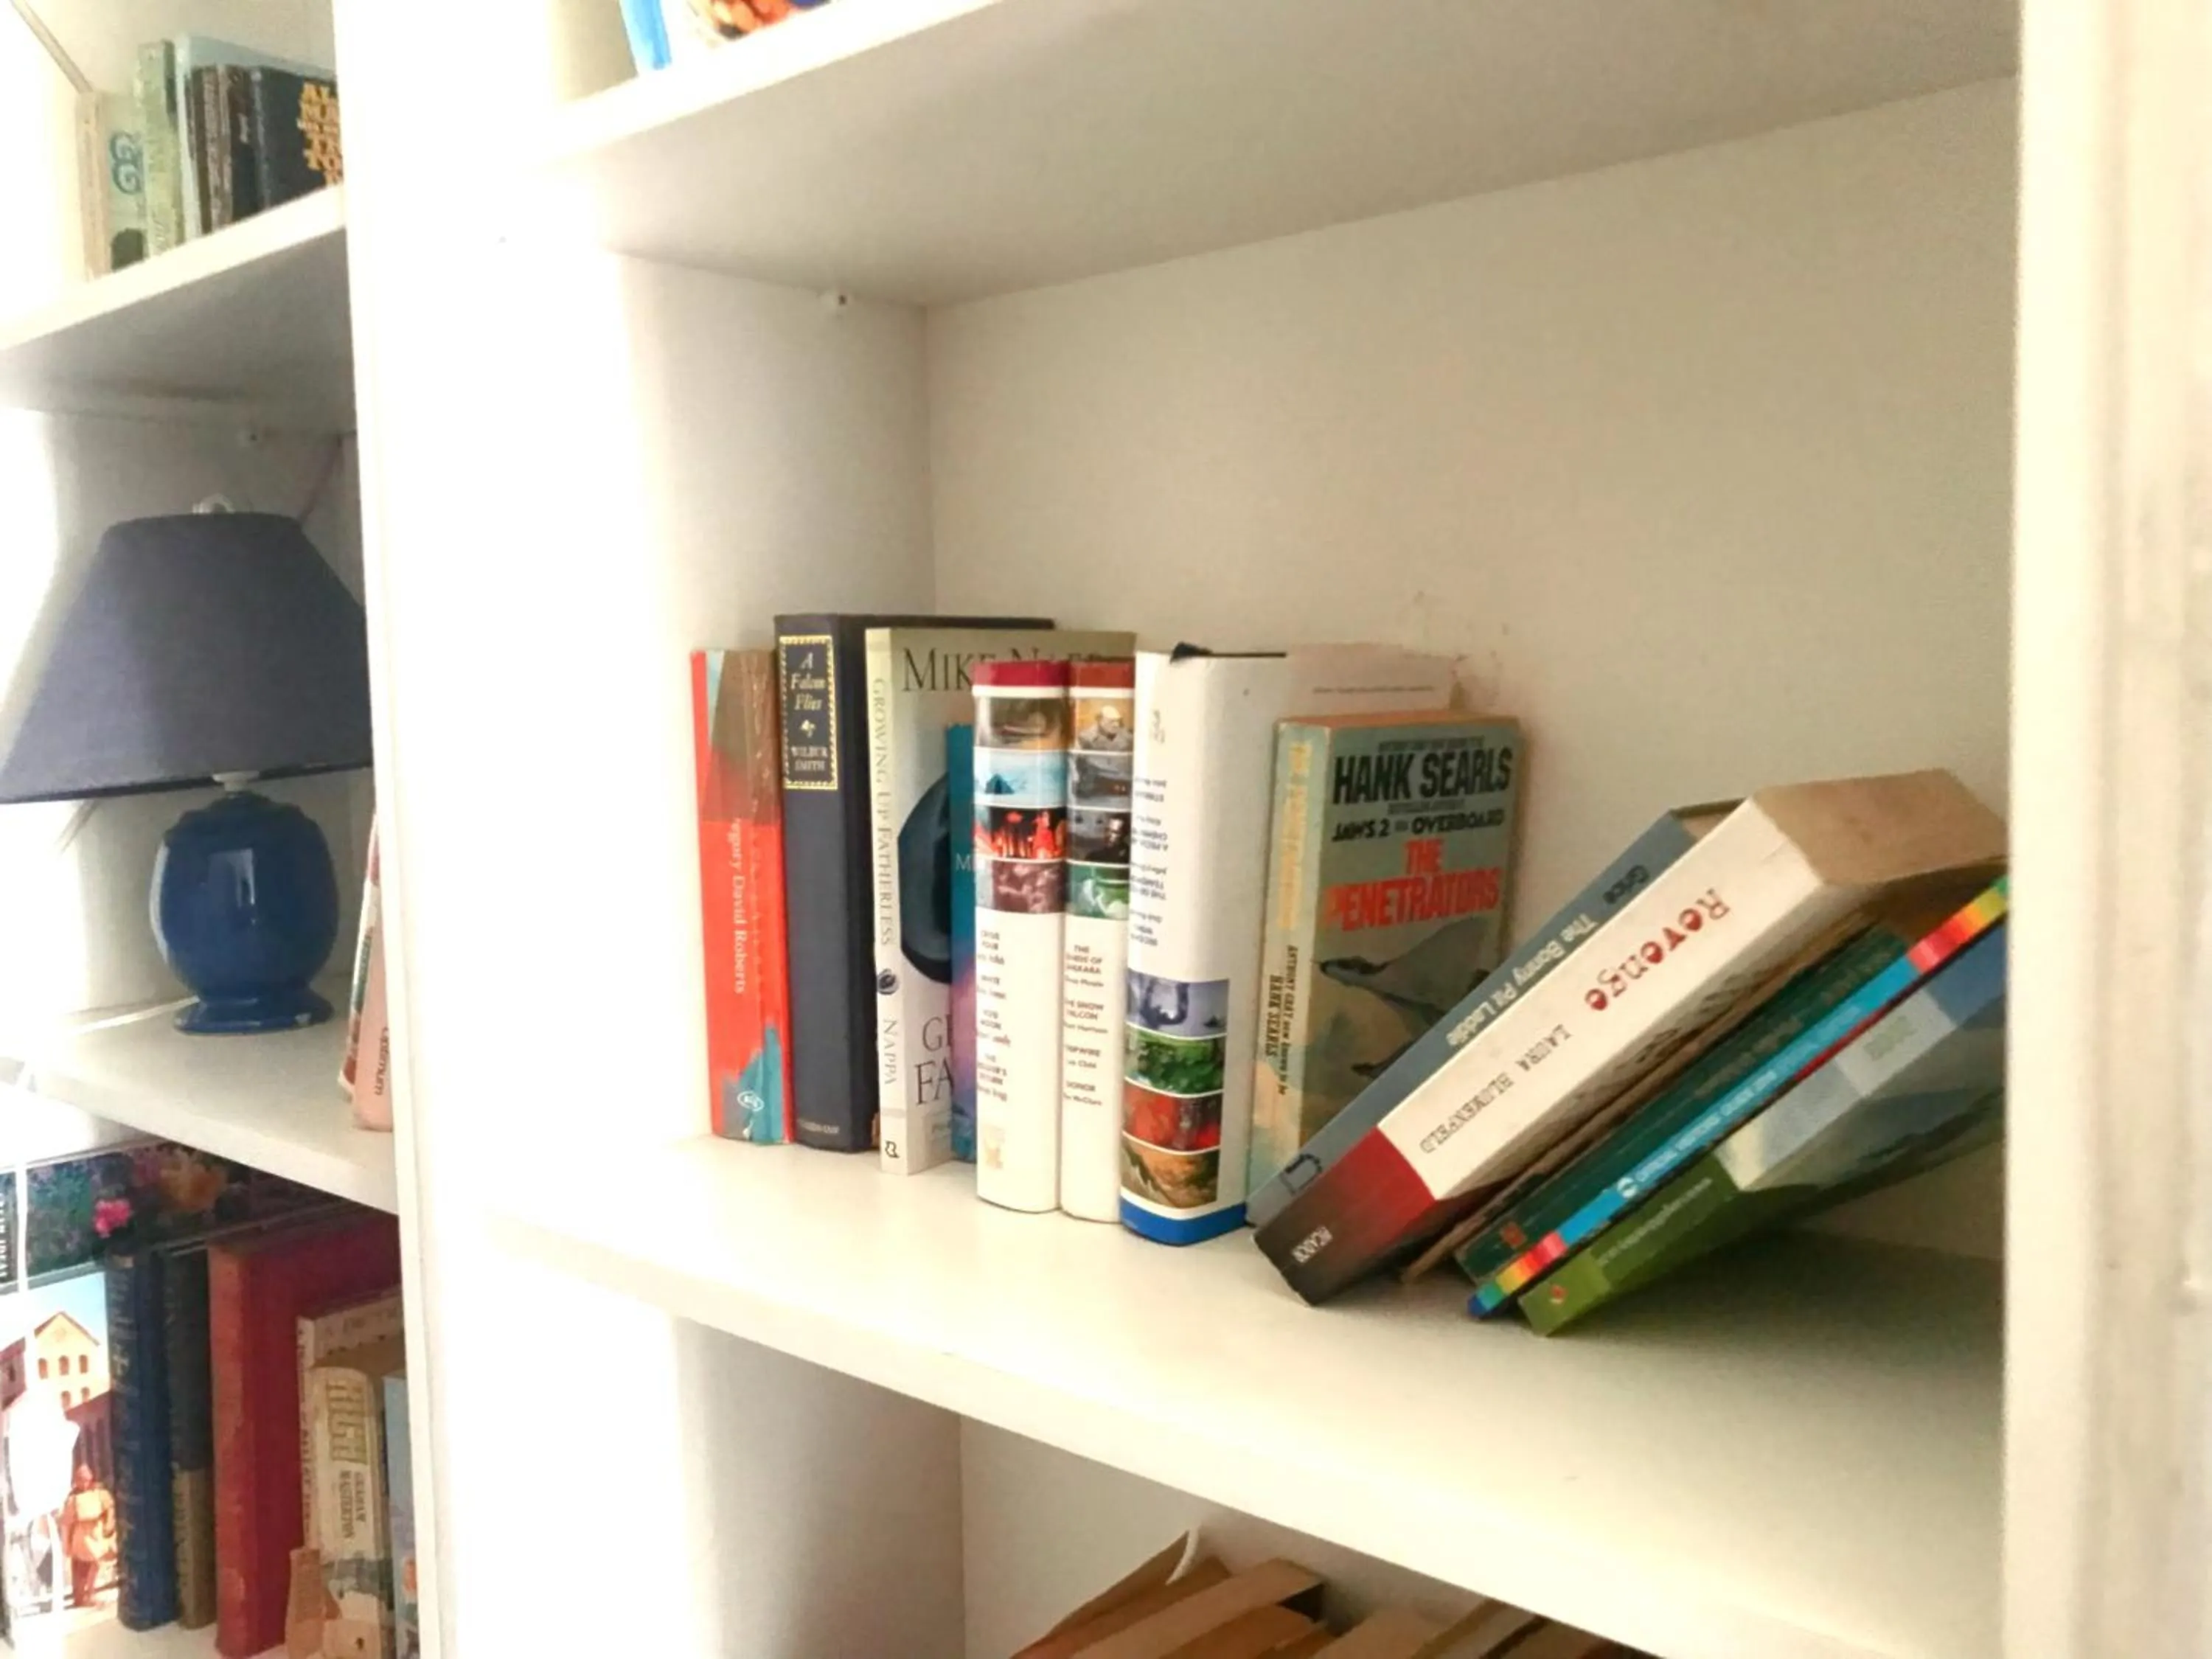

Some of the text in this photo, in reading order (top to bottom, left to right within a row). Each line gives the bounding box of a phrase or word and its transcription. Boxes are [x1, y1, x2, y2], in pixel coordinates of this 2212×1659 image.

[790, 672, 826, 689] Falcon
[801, 652, 813, 669] A
[794, 692, 823, 711] Flies
[795, 759, 826, 771] SMITH
[1332, 753, 1416, 804] HANK
[1419, 745, 1513, 798] SEARLS
[873, 678, 894, 947] GROWING UP FATHERLESS
[1332, 818, 1376, 841] JAWS
[1378, 818, 1391, 837] 2
[1412, 809, 1505, 835] OVERBOARD
[1406, 838, 1444, 874] THE
[726, 816, 748, 993] egory David Roberts
[1321, 868, 1503, 931] PENETRATORS
[1559, 913, 1598, 942] The
[1584, 888, 1731, 1011] Revenge
[1512, 940, 1565, 987] Bonny
[1265, 975, 1284, 1057] HANK SEARLS
[1490, 981, 1517, 1007] Pit
[1445, 1001, 1497, 1046] Laddie
[883, 1018, 898, 1085] NAPPA
[1514, 1023, 1573, 1071] LAURA
[1419, 1071, 1515, 1154] BLUMENFELD
